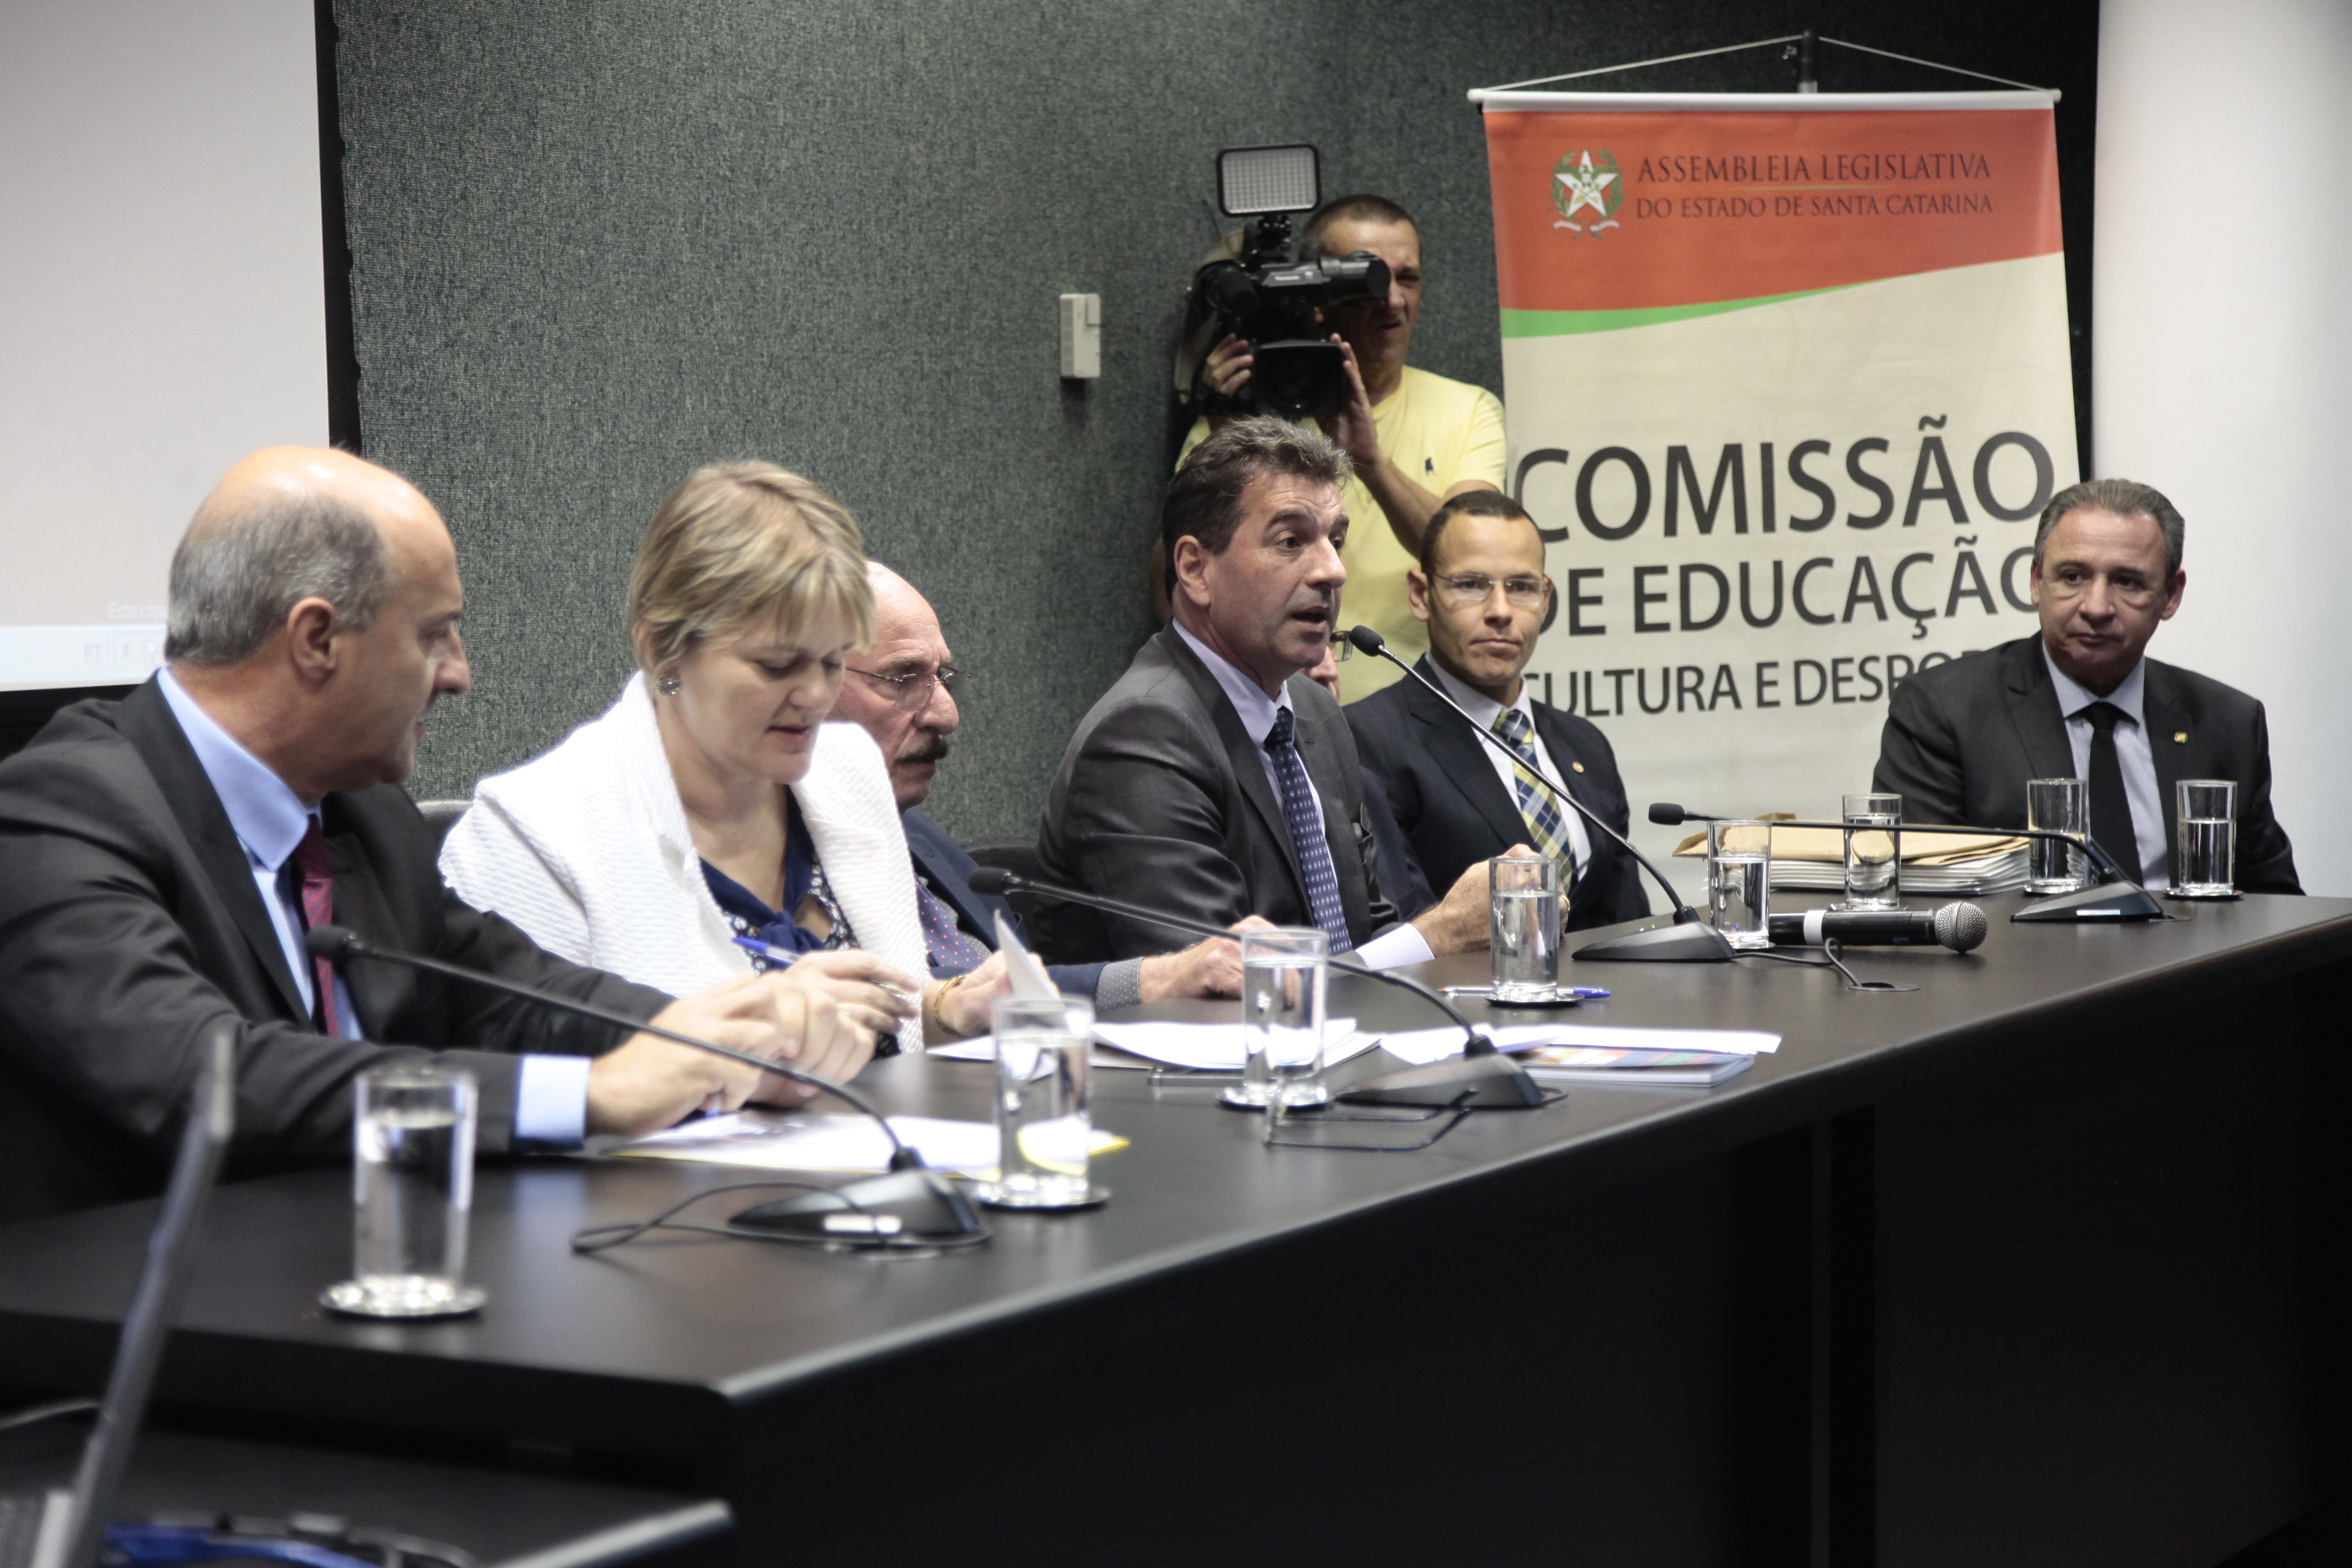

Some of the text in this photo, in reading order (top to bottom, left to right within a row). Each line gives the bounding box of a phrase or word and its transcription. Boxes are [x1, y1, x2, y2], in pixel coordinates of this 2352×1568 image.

[1636, 154, 1992, 182] ASSEMBLEIA LEGISLATIVA
[1636, 194, 1994, 219] DO ESTADO DE SANTA CATARINA
[1514, 414, 2055, 542] COMISSÃO
[1522, 663, 1742, 717] ULTURA
[1756, 661, 1781, 708] E
